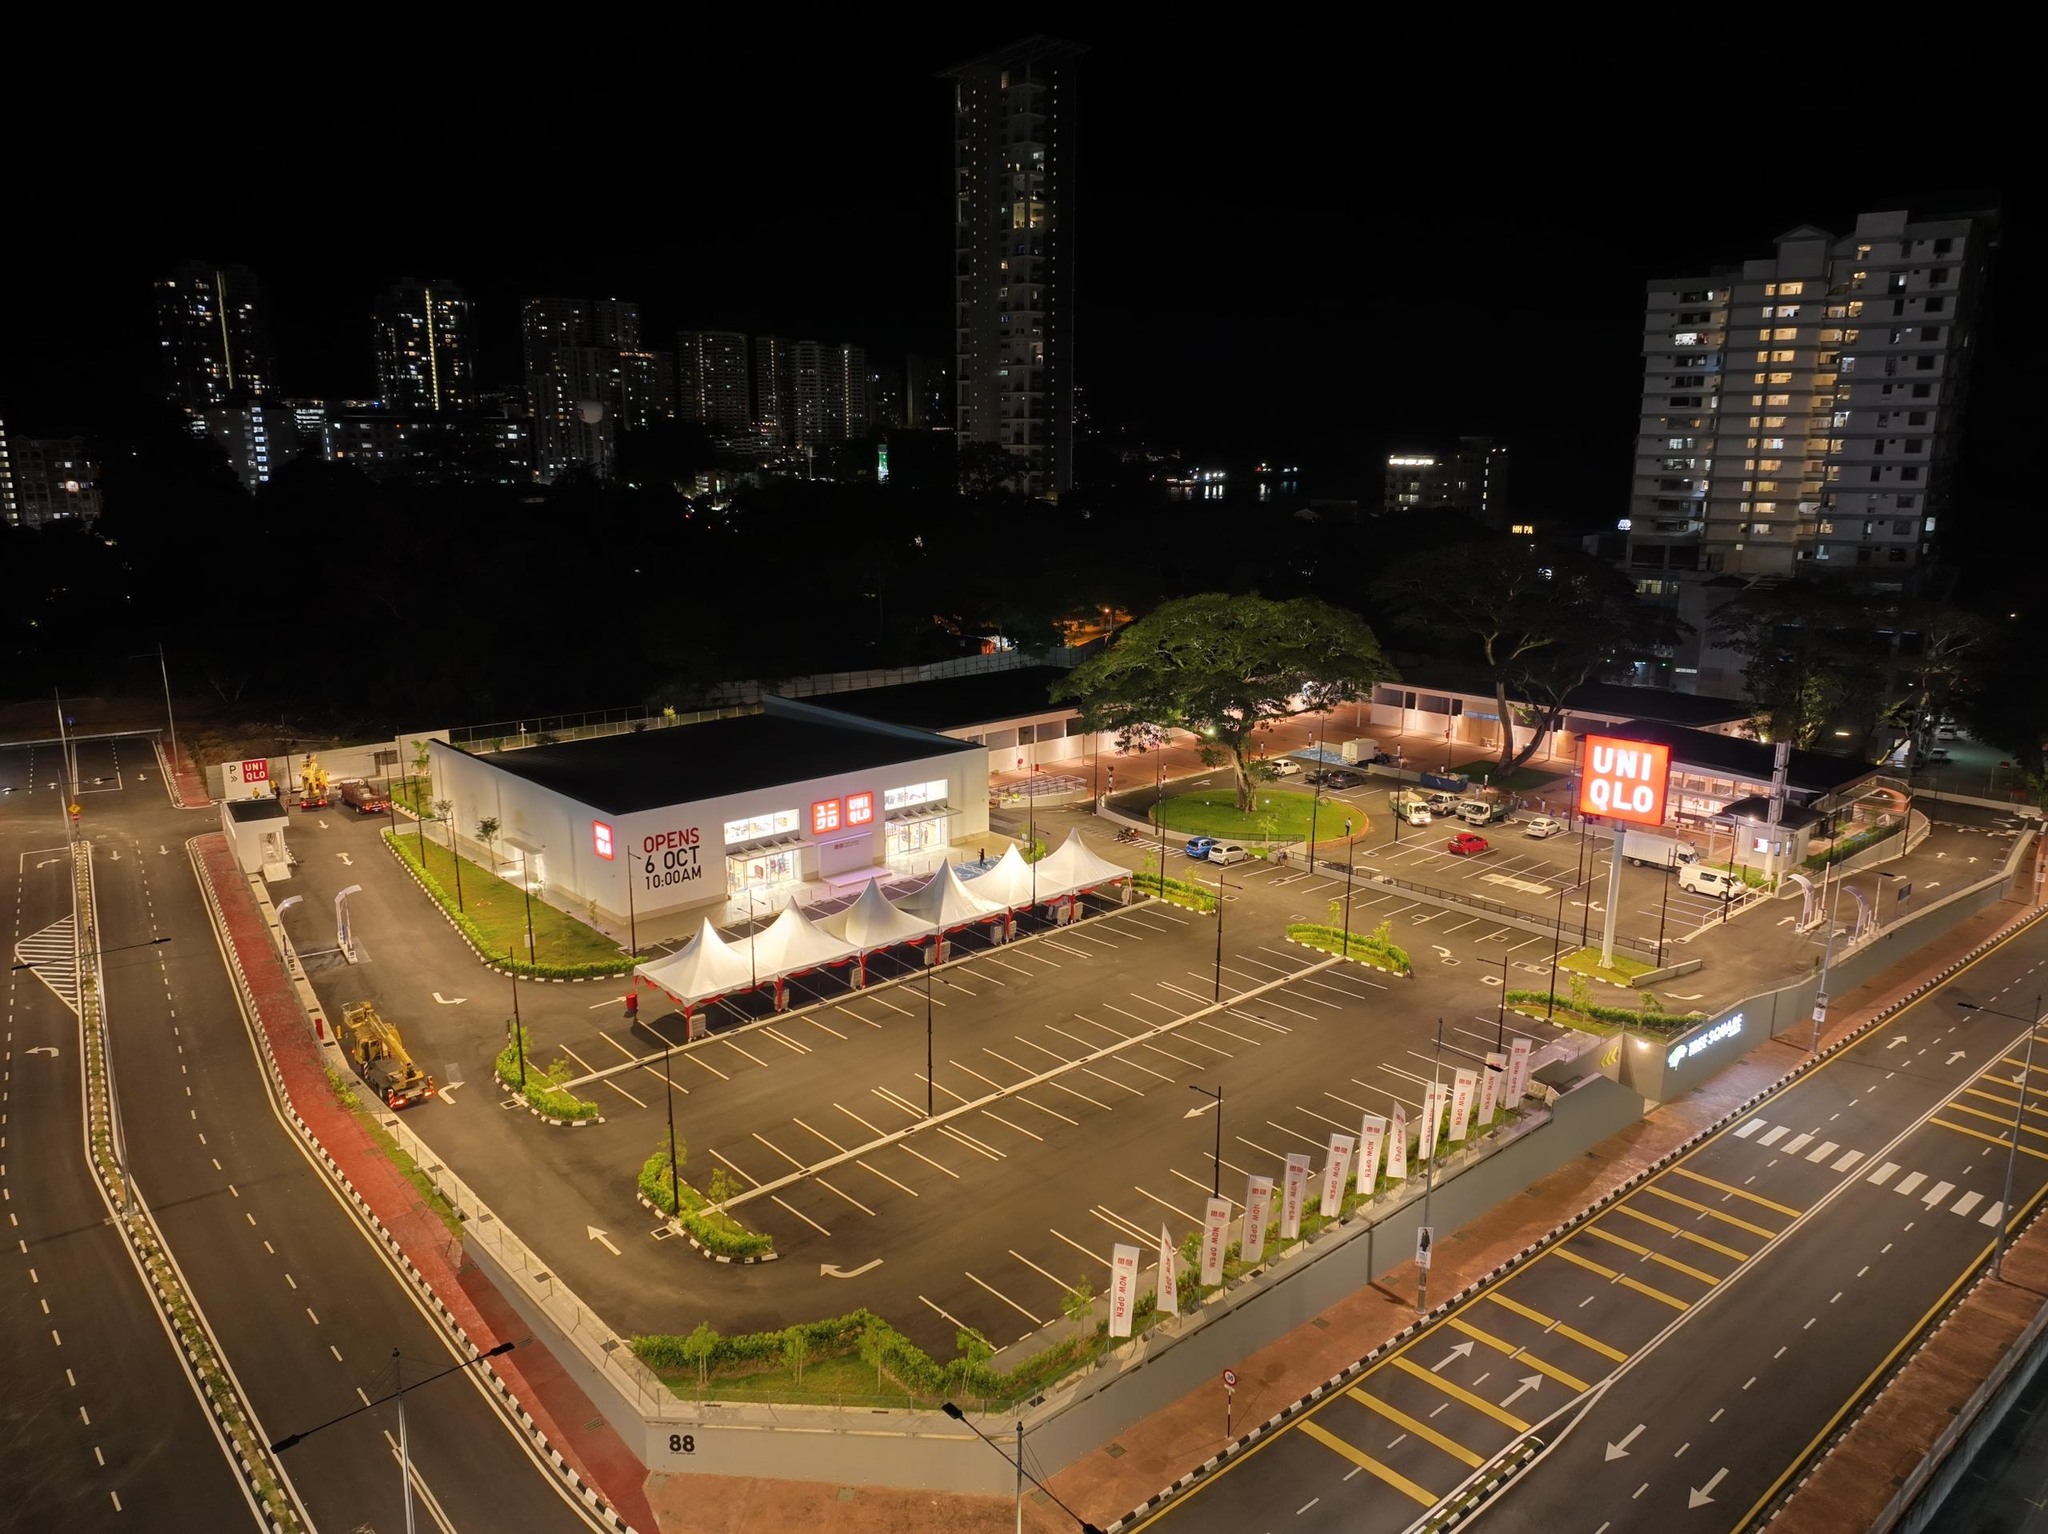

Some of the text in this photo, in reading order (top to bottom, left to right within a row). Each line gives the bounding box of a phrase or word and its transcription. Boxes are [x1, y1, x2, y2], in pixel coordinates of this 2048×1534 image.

[229, 765, 236, 774] P
[245, 762, 263, 771] UNI
[1593, 745, 1652, 781] UNI
[246, 771, 265, 781] QLO
[849, 796, 868, 810] UNI
[1590, 778, 1653, 813] QLO
[816, 803, 837, 817] ユニ
[850, 808, 870, 824] QLO
[644, 827, 699, 853] OPENS
[645, 845, 700, 873] 6 OCT
[645, 865, 701, 890] 10:00AM
[1459, 1092, 1467, 1107] NOW
[1367, 1141, 1375, 1157] NOW
[1332, 1161, 1341, 1178] NOW
[1330, 1180, 1338, 1200] OPEN
[1251, 1204, 1260, 1221] NOW
[1211, 1227, 1219, 1244] NOW
[1249, 1224, 1258, 1245] OPEN
[1209, 1247, 1217, 1268] OPEN
[1118, 1275, 1128, 1294] NOW
[1116, 1296, 1126, 1318] OPEN
[669, 1434, 695, 1453] 88
